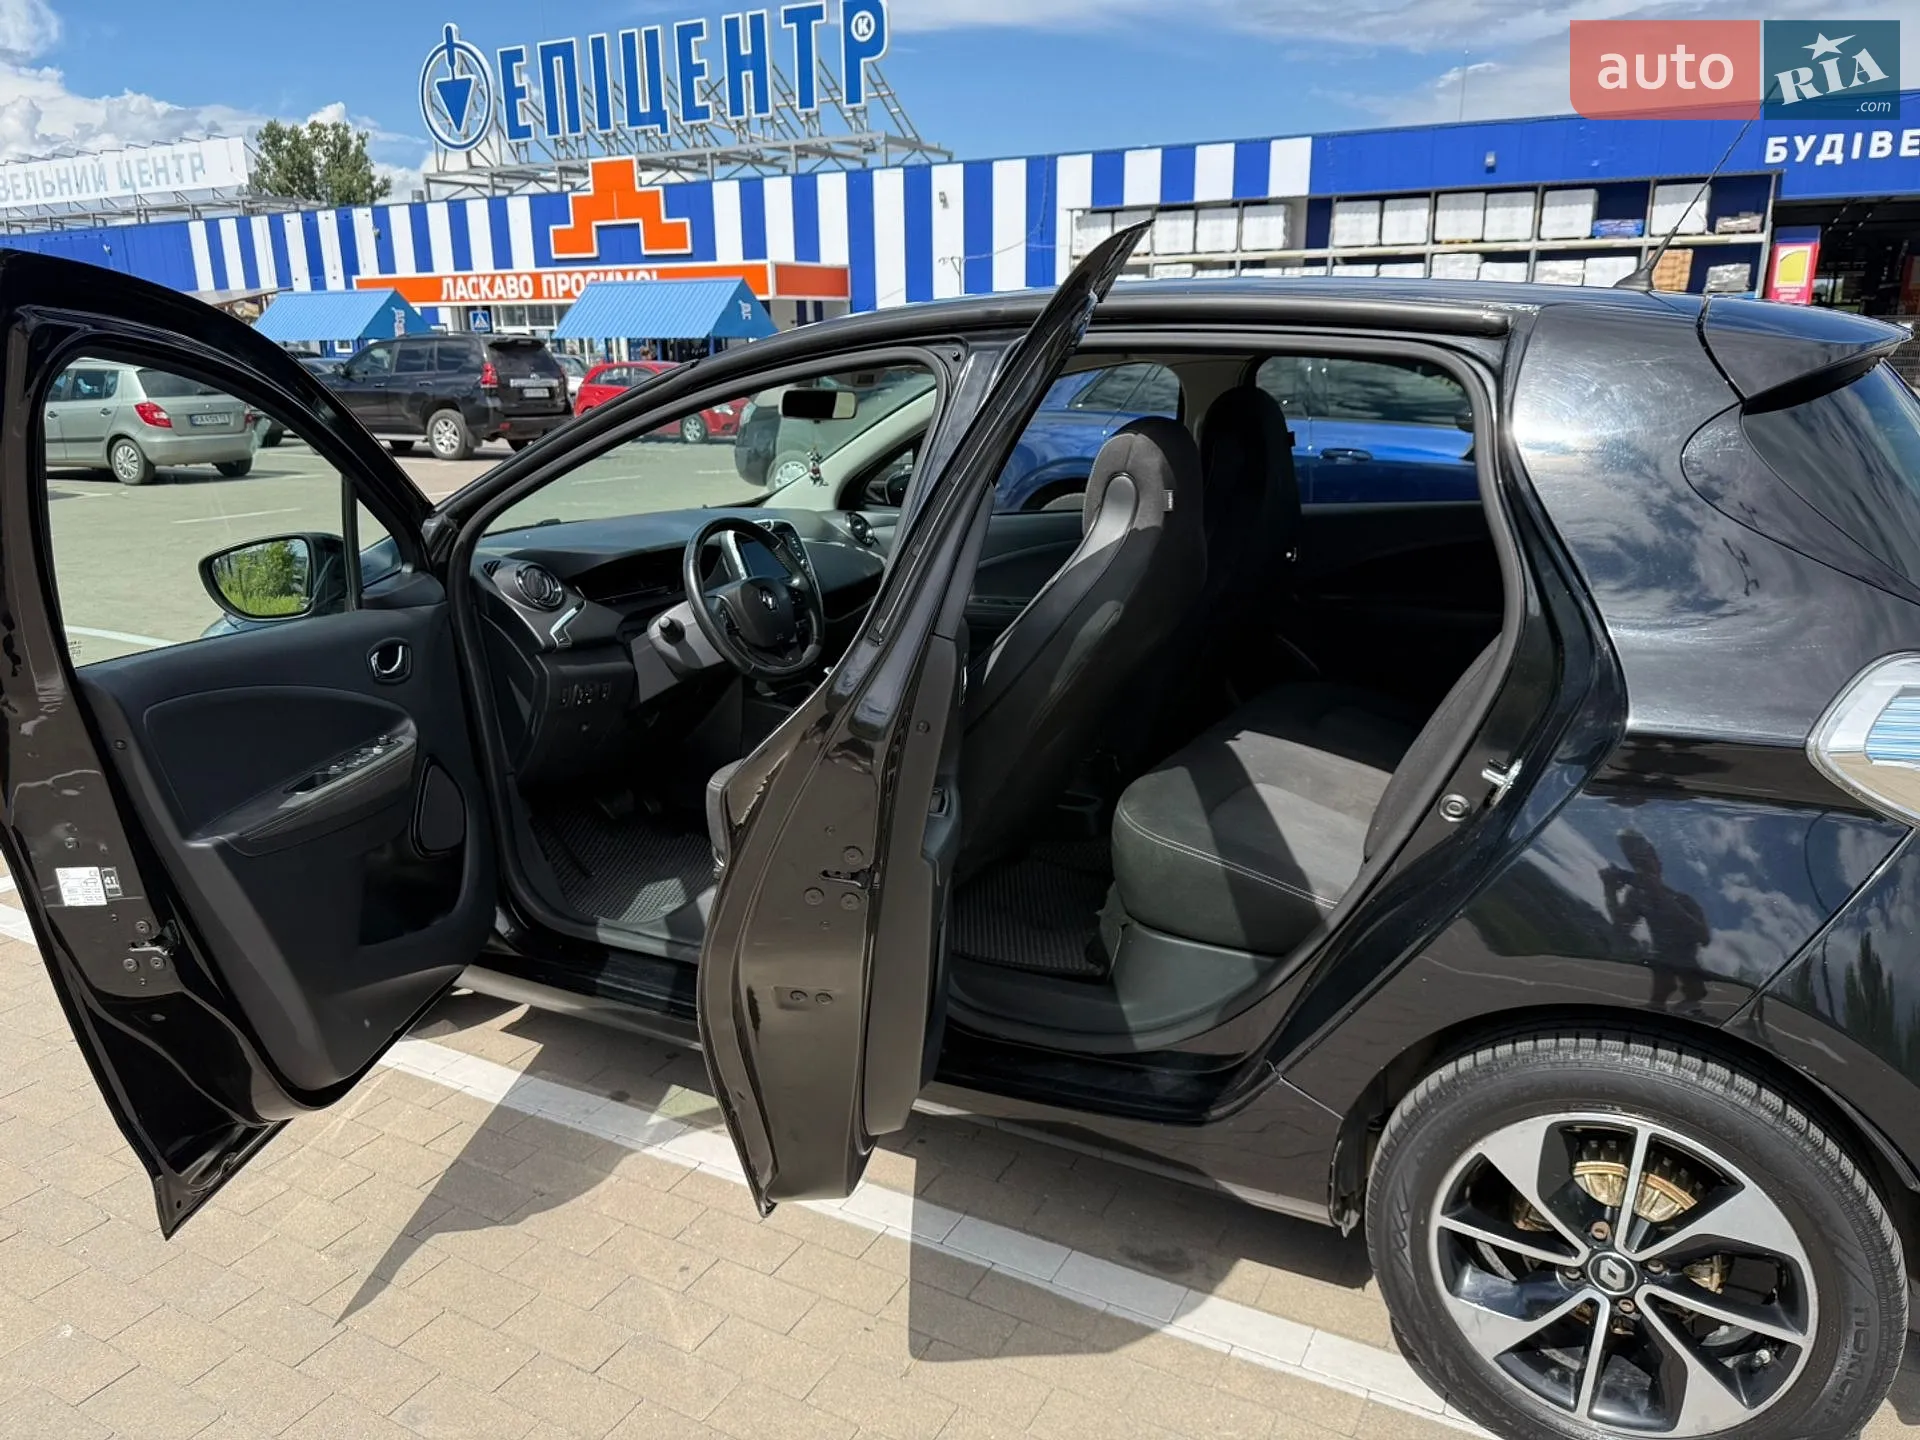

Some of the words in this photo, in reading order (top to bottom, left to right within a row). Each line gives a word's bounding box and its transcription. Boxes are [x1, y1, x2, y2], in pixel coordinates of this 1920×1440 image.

[497, 0, 888, 143] ЕПІЦЕНТР
[116, 150, 206, 193] ЦЕНТР
[441, 274, 534, 300] ЛАСКАВО
